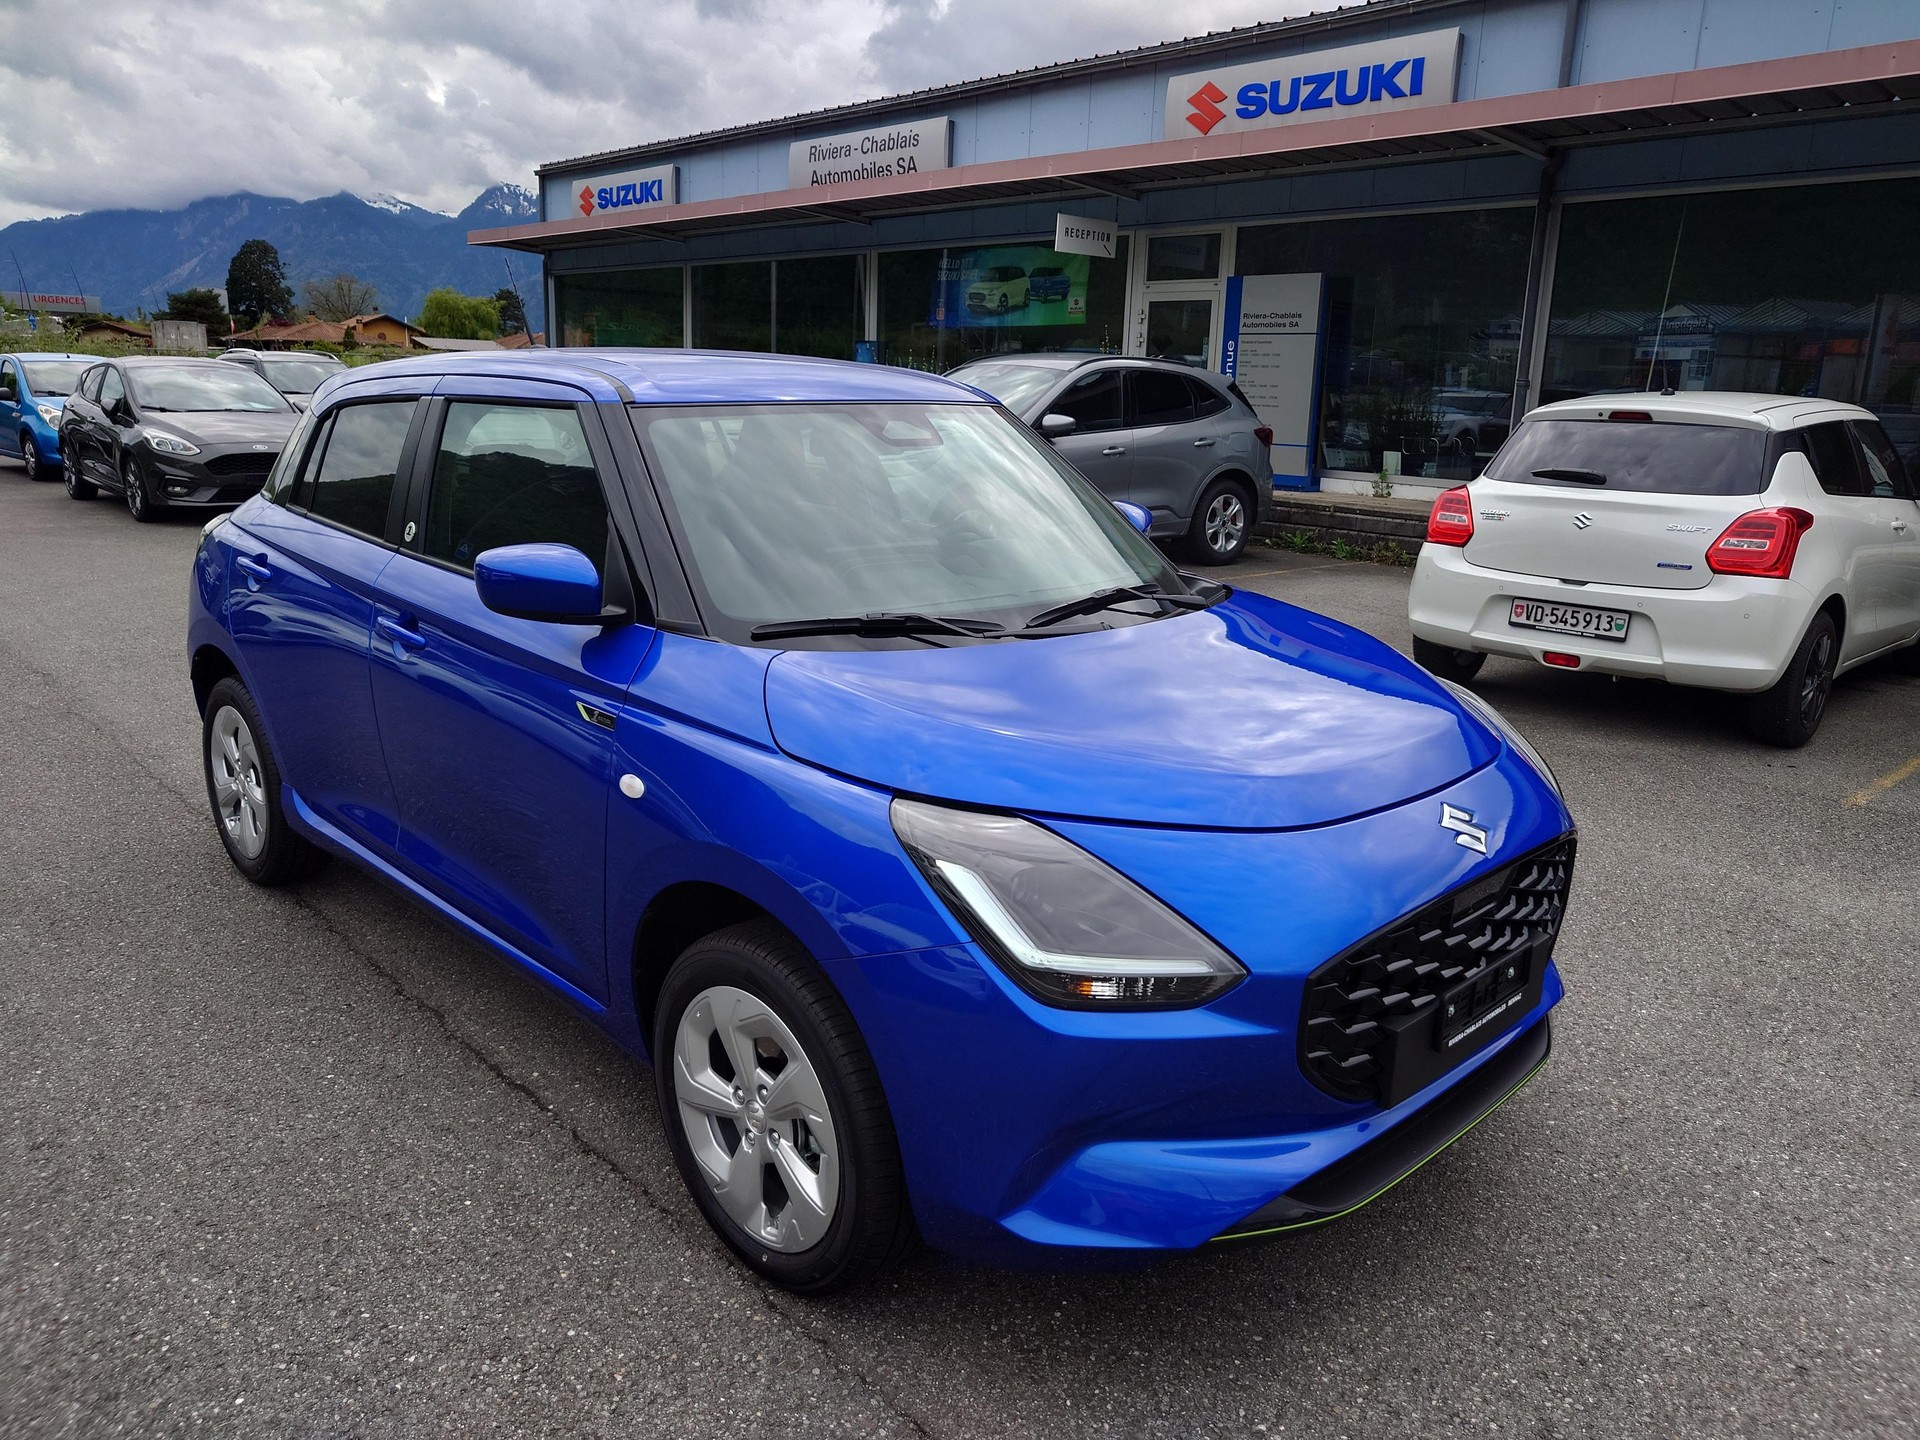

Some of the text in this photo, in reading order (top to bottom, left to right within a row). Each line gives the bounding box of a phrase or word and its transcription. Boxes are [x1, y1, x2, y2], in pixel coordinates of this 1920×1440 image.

[1235, 57, 1426, 119] SUZUKI
[811, 156, 918, 186] Automobiles SA
[597, 179, 663, 209] SUZUKI
[1064, 227, 1111, 242] RECEPTION
[33, 295, 86, 305] URGENCES
[1242, 312, 1303, 320] Riviera-Chablais
[1241, 321, 1287, 329] Automobiles
[1666, 523, 1712, 534] SWIFT
